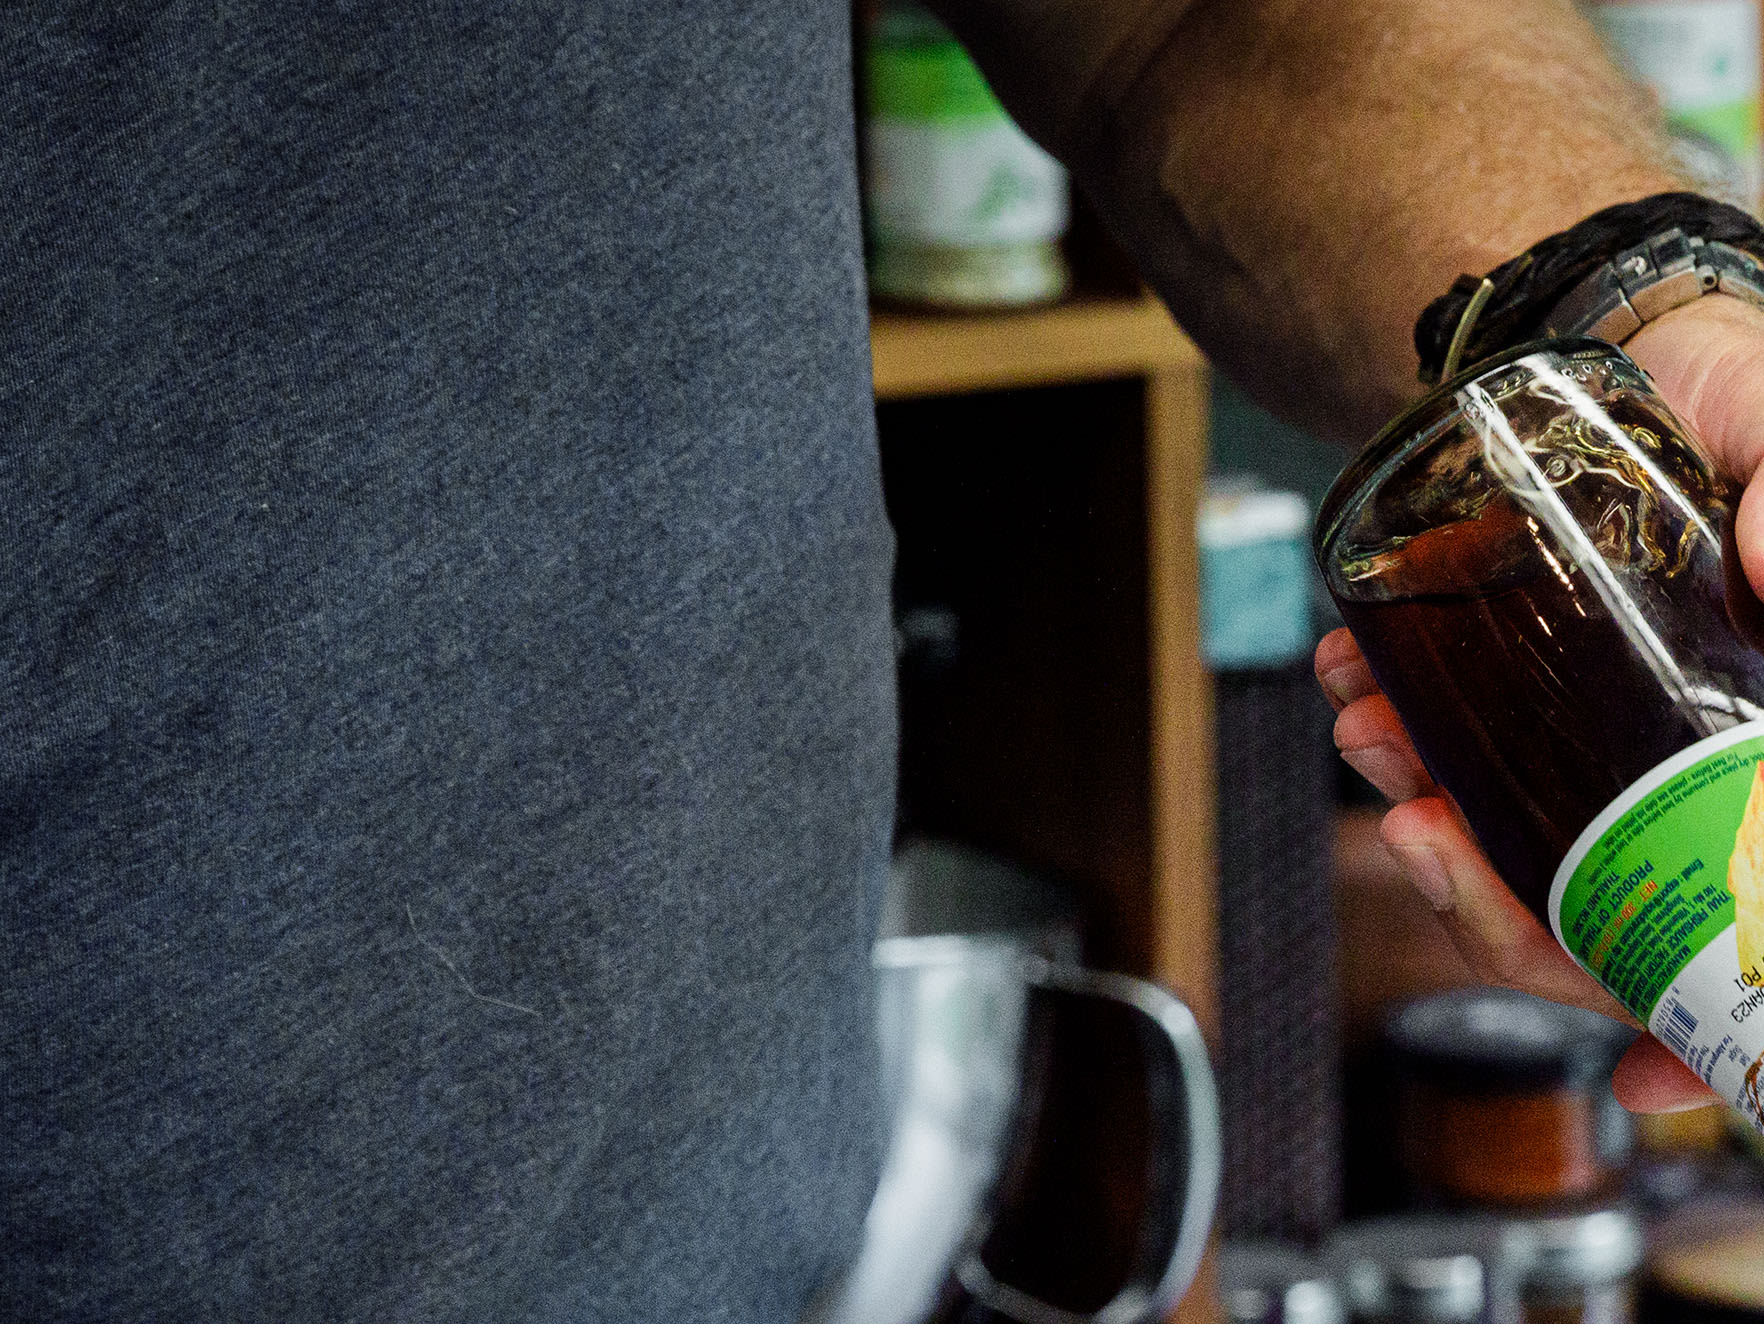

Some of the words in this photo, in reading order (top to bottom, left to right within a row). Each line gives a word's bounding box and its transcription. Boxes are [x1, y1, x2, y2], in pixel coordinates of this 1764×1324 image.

[1607, 859, 1653, 910] PRODUCT
[1638, 879, 1658, 901] NET
[1705, 889, 1731, 912] THAI
[1596, 908, 1610, 925] OF
